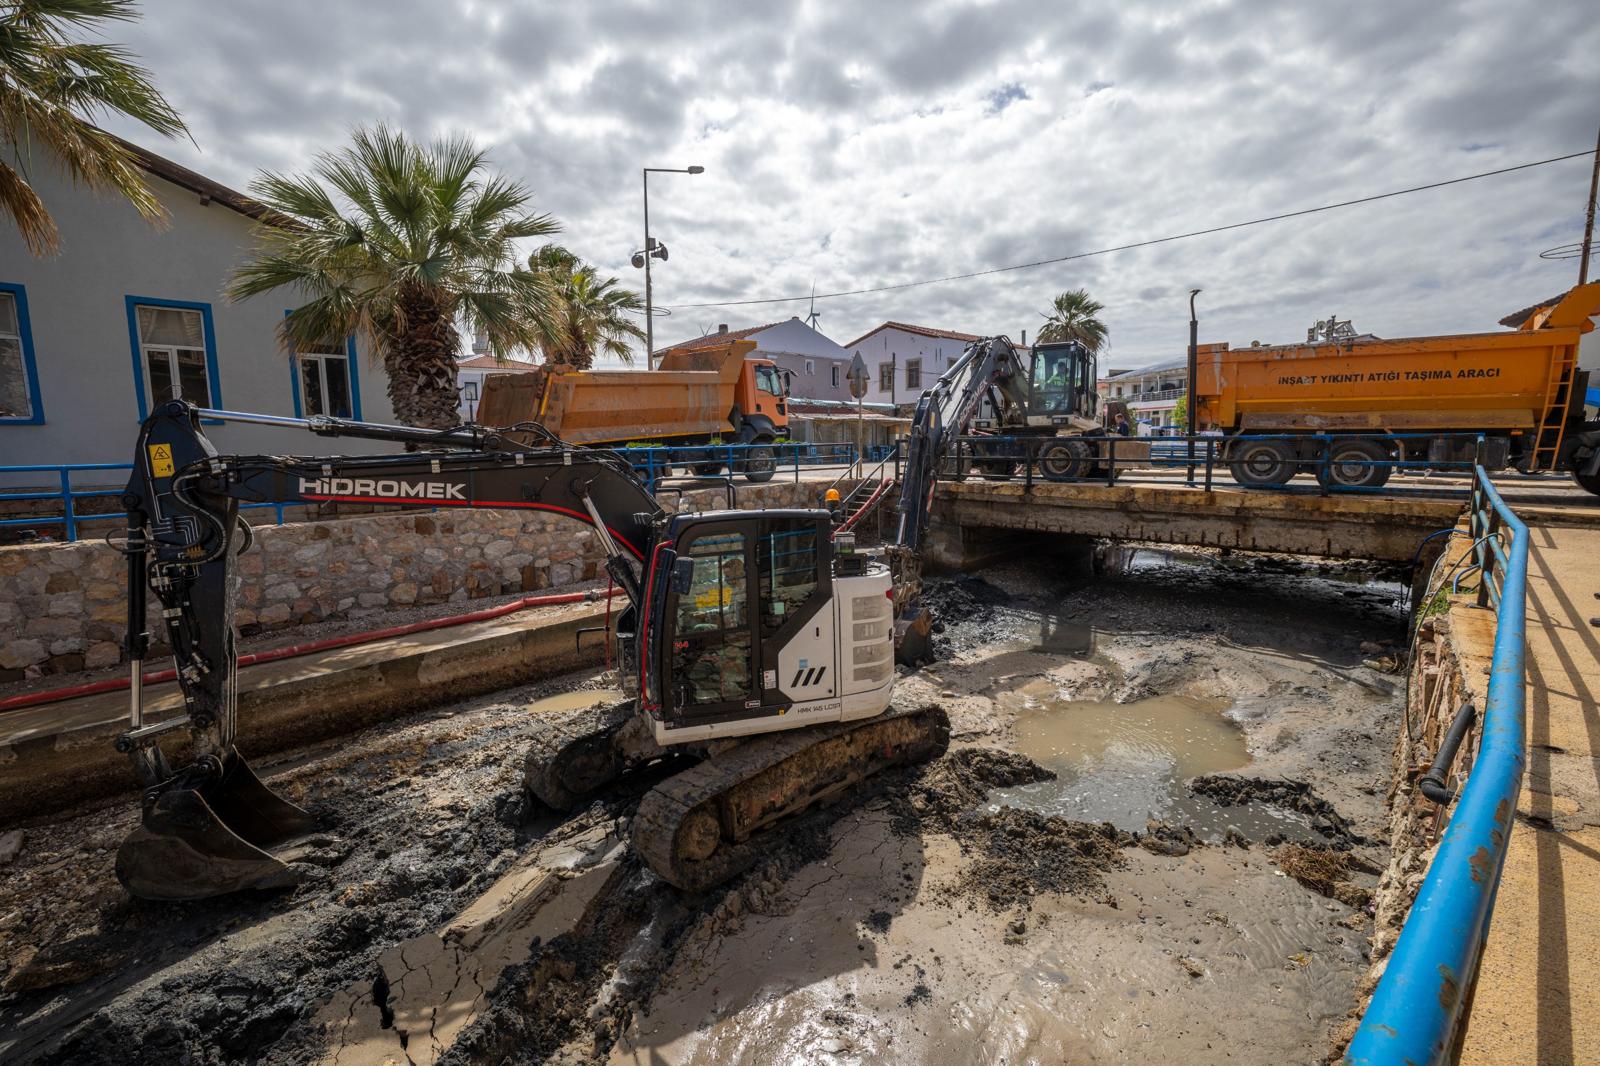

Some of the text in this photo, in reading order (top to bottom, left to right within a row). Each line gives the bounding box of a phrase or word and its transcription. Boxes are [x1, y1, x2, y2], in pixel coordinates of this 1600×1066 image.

[1321, 373, 1364, 384] YIKINTI
[1405, 369, 1452, 381] TAŞIMA
[1457, 367, 1501, 379] ARACI
